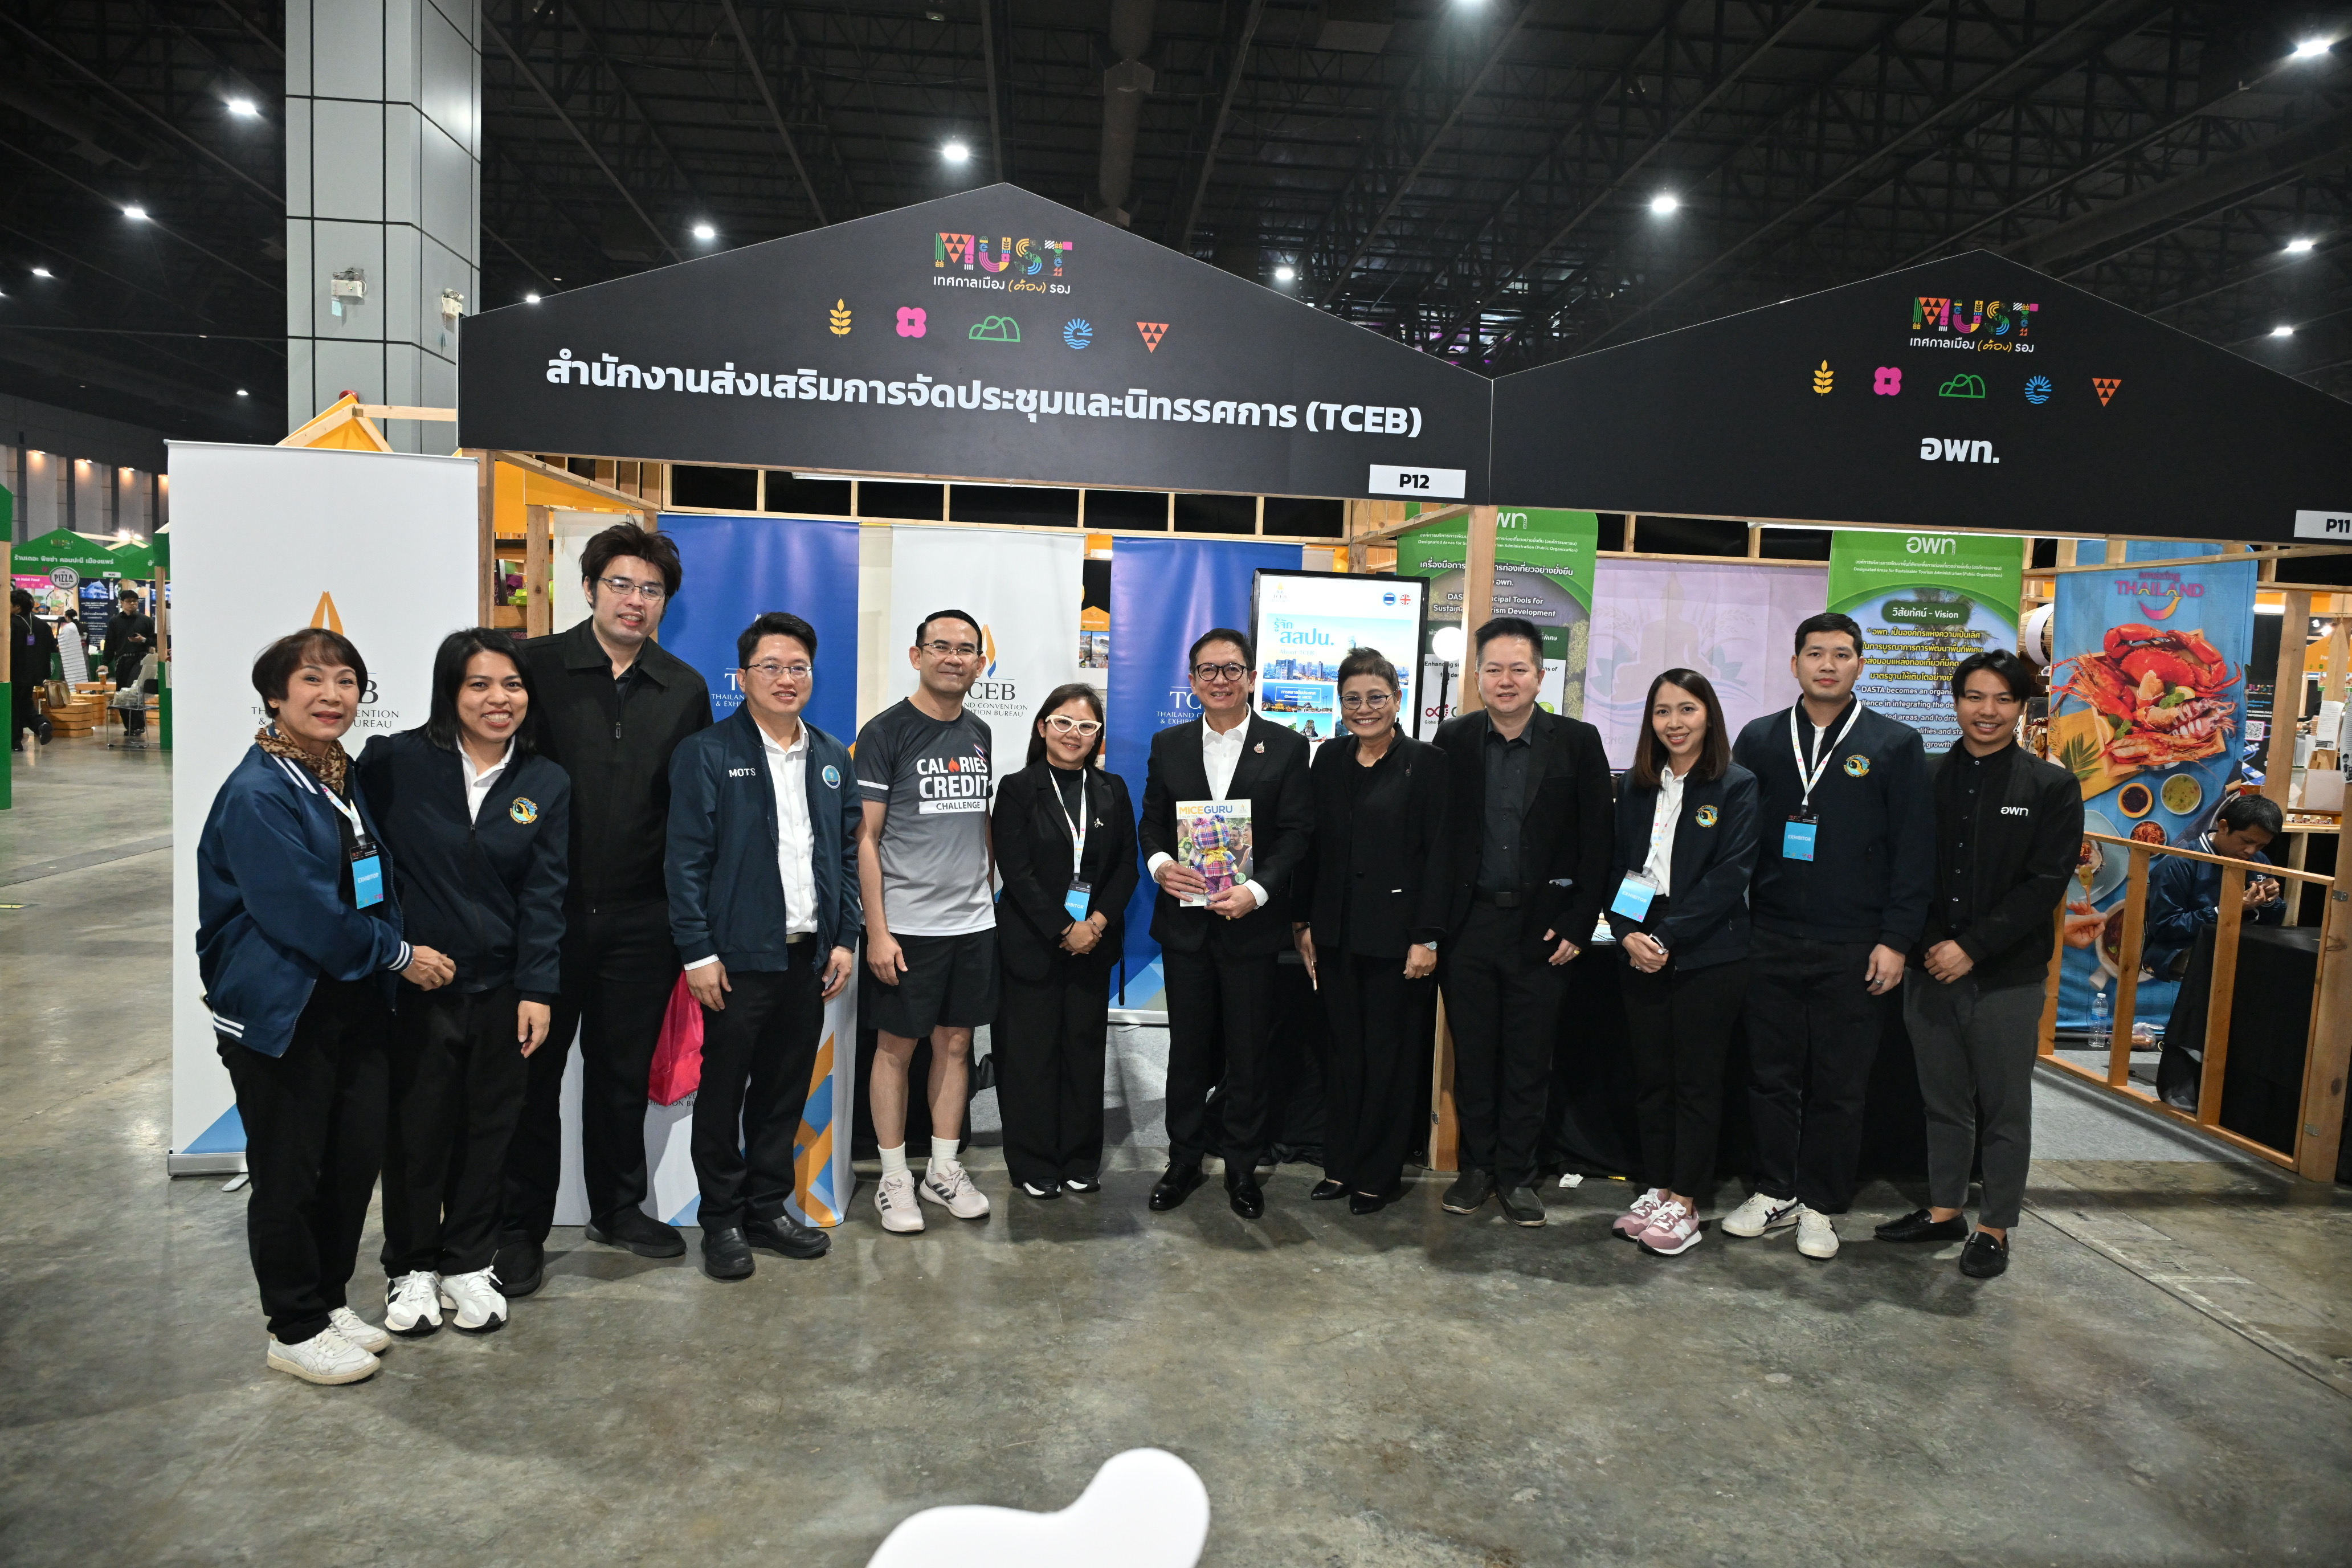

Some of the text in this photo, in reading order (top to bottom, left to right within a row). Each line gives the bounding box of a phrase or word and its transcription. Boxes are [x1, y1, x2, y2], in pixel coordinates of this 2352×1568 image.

[935, 232, 1072, 276] MUST
[933, 276, 1071, 294] เทศกาลเมือง (ต้อง) รอง
[1913, 297, 2039, 336] MUST
[1910, 337, 2034, 353] เทศกาลเมือง (ต้อง) รอง
[546, 348, 1422, 438] สำนักงานส่งเสริมการจัดประชุมและนิทรรศการ (TCEB)
[1920, 437, 2000, 464] อพท.
[1399, 472, 1430, 490] P12
[1496, 512, 1527, 529] พท
[2326, 518, 2351, 533] P11
[54, 574, 74, 582] PIZZA
[2114, 580, 2204, 597] THAILAND
[1508, 607, 1556, 617] Development
[1892, 606, 1927, 617] วิสัยทัศน์
[1934, 610, 1959, 619] Vision
[1273, 618, 1293, 632] รู้จัก
[1891, 626, 1981, 639] เป็นองค์กรแห่งความเป็นเลิศ
[1279, 628, 1334, 646] สสปน.
[1869, 671, 1953, 682] มาตรฐานให้เติบโตอย่างยั่
[967, 681, 1016, 700] CEB
[1169, 691, 1202, 709] TC
[1892, 700, 1931, 709] integrating
[356, 709, 399, 718] ENTION
[354, 720, 392, 728] UREAU
[729, 767, 756, 778] MOTS
[917, 757, 987, 775] CALORIES
[919, 775, 989, 799] CREDIT
[936, 801, 980, 810] CHALLENGE
[1179, 805, 1233, 814] MICEGURU
[1622, 891, 1648, 903] EXHIBITOR
